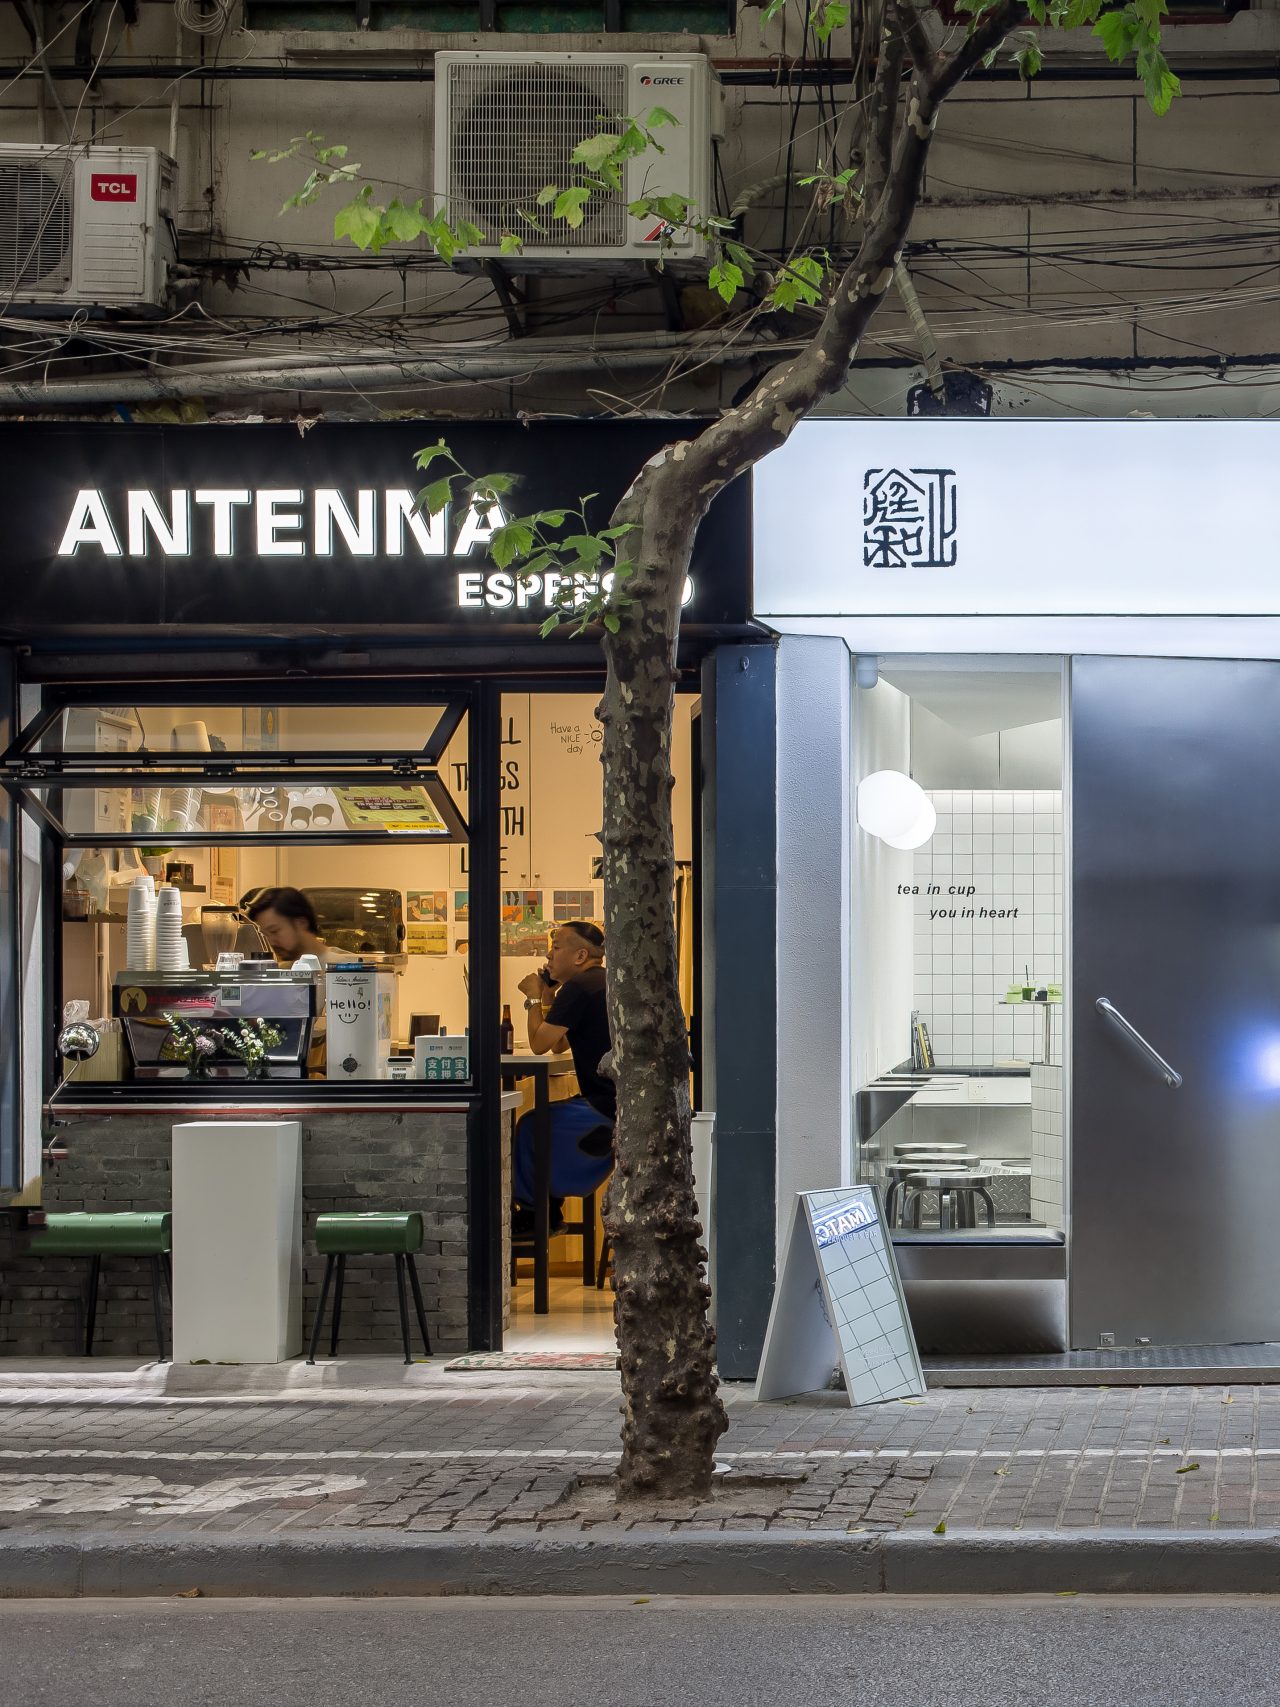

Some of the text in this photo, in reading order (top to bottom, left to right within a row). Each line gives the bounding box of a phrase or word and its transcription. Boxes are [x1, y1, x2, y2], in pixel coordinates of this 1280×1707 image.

[653, 77, 685, 85] GREE
[98, 182, 130, 195] TCL
[58, 488, 512, 557] ANTENNA
[550, 722, 573, 734] Have
[561, 734, 581, 743] NICE
[567, 745, 583, 754] day
[897, 883, 976, 897] tea in cup
[929, 906, 1019, 920] you in heart
[330, 1000, 371, 1010] Hello!
[427, 1059, 465, 1069] 支付宝
